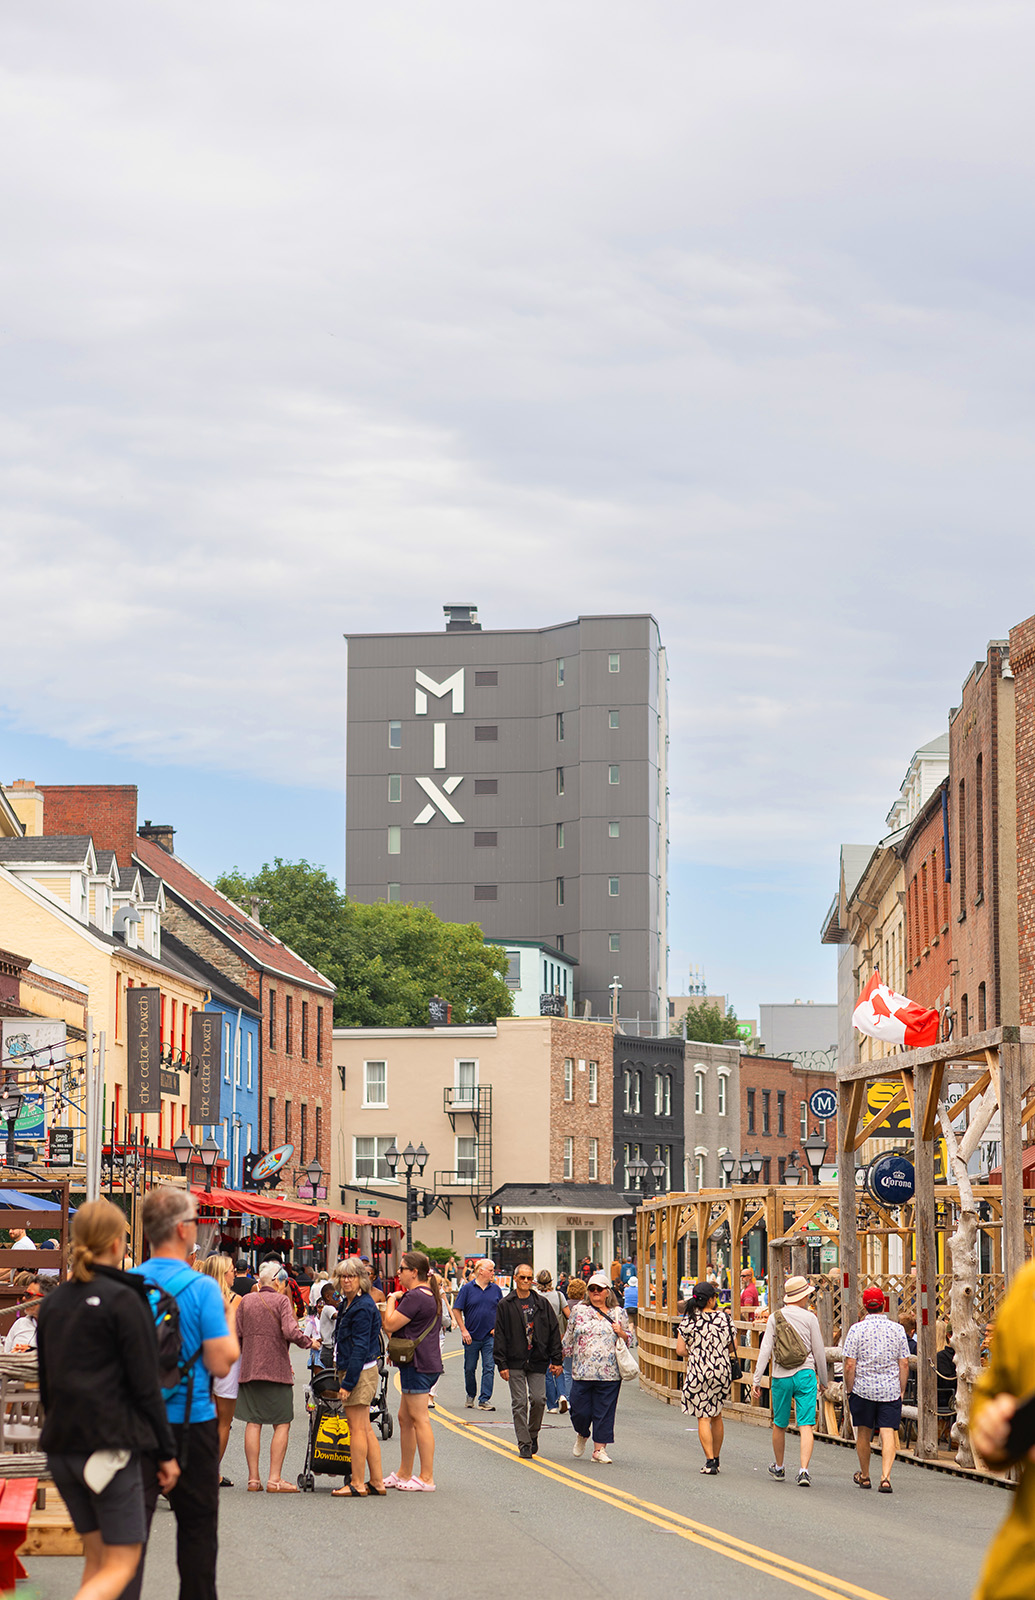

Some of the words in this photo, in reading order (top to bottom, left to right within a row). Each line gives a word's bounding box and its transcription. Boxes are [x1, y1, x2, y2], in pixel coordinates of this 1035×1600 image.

[413, 667, 466, 825] MIX
[817, 1096, 832, 1111] M
[880, 1175, 913, 1188] Corona
[500, 1216, 529, 1226] ONIA
[314, 1449, 352, 1463] Downhome
